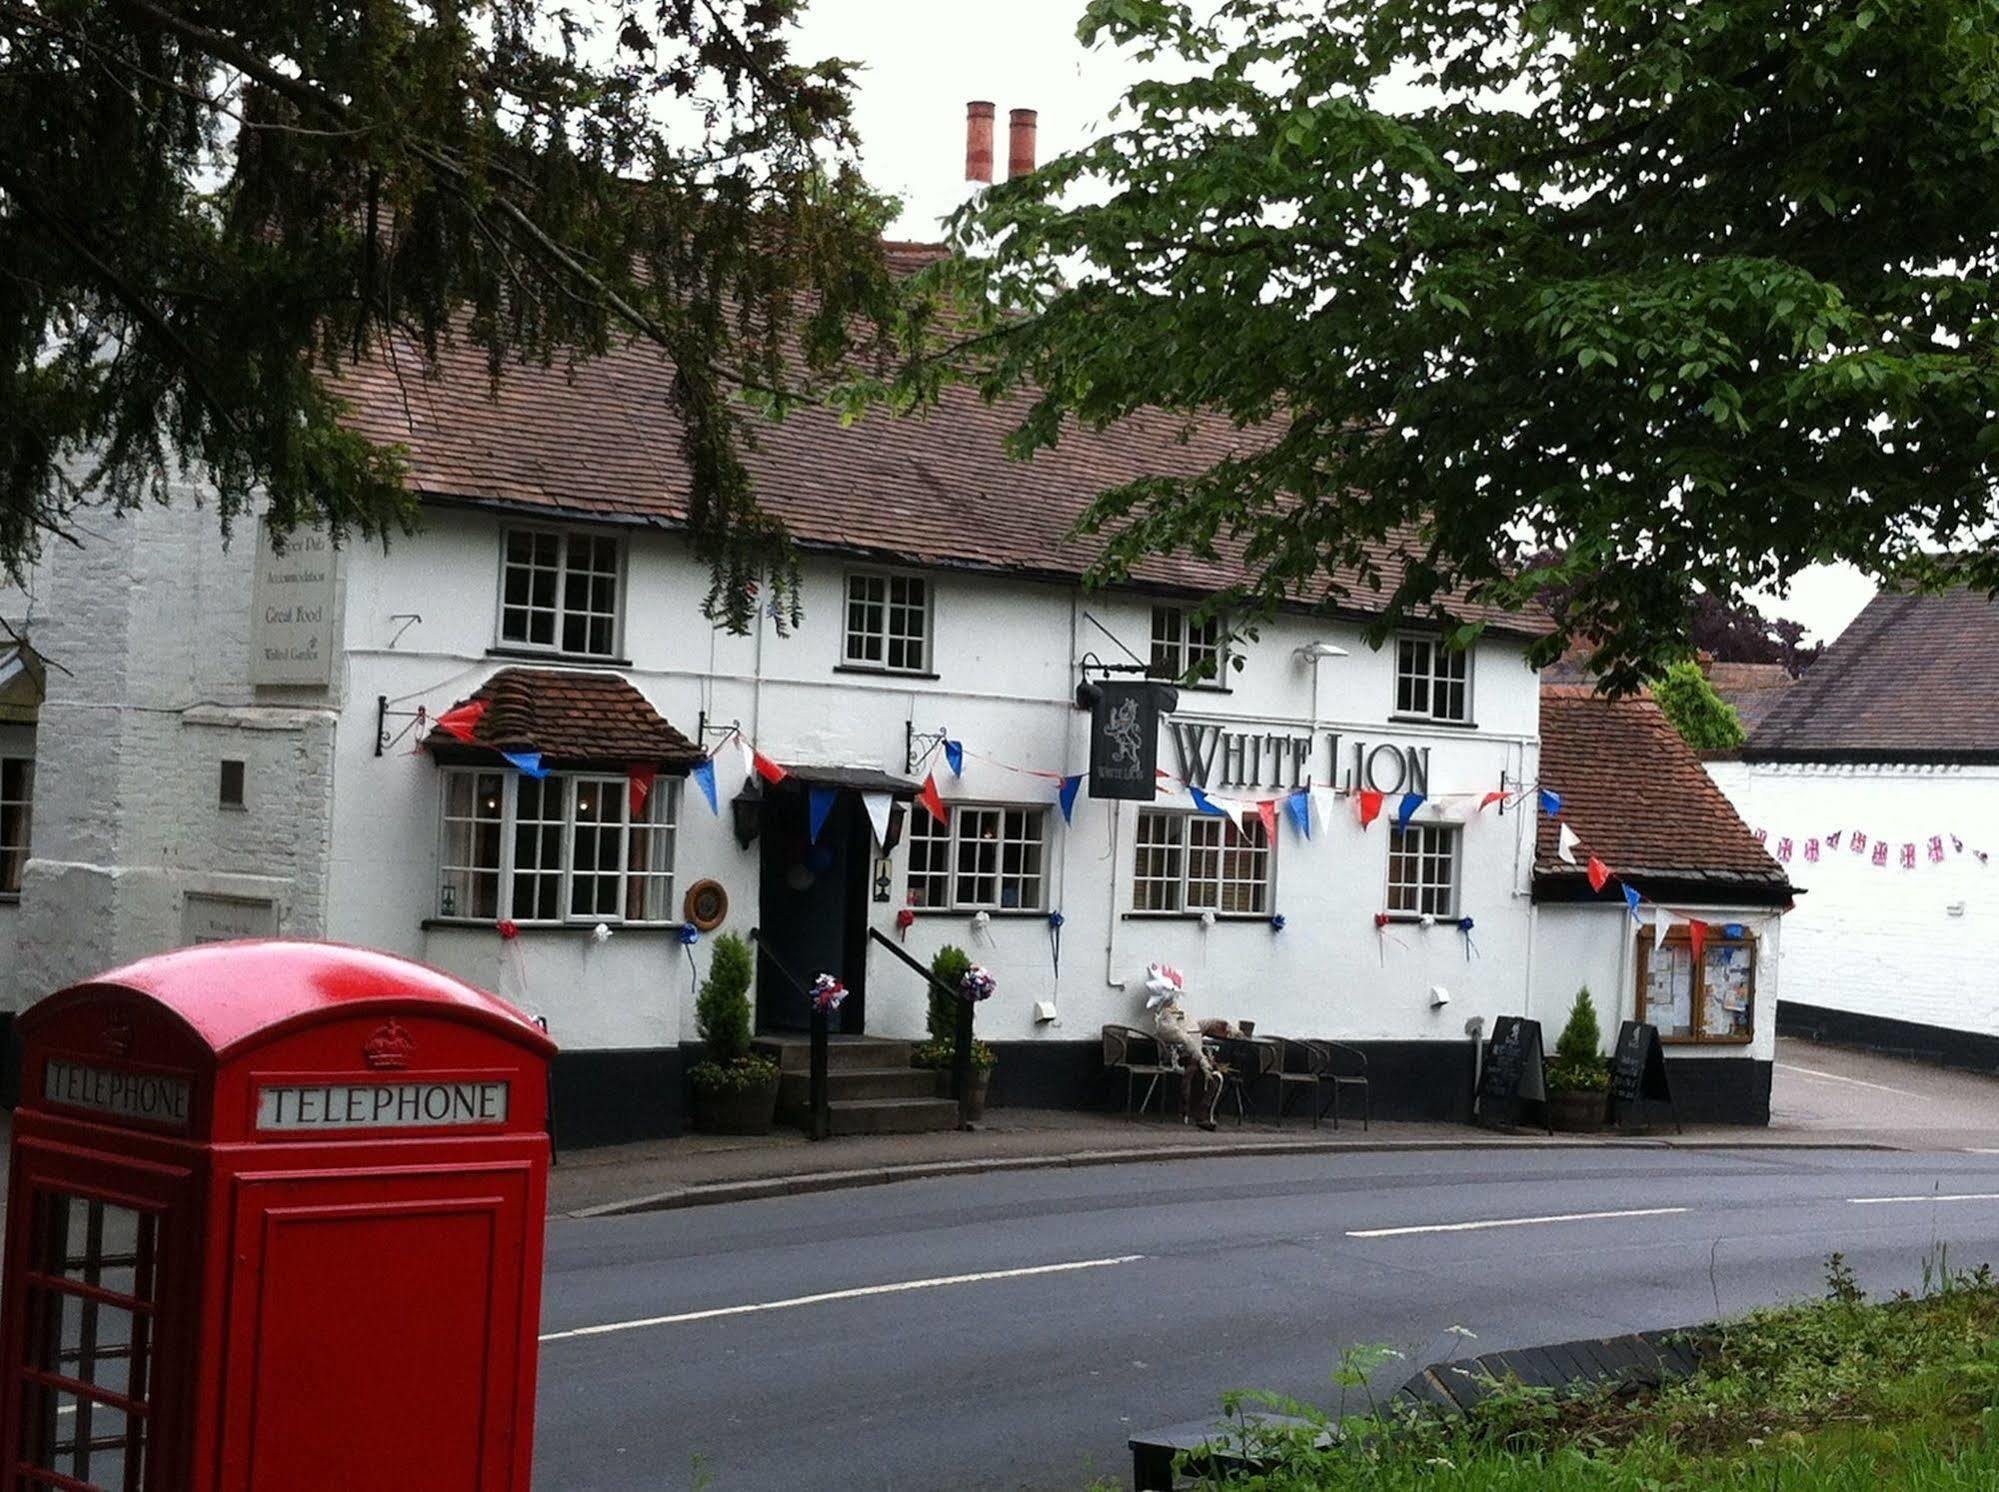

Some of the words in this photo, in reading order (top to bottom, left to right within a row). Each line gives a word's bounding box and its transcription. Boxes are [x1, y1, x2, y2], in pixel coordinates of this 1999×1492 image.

[265, 606, 292, 624] Great
[296, 604, 323, 624] Food
[1168, 721, 1312, 793] WHITE
[1327, 733, 1431, 801] LION
[50, 1061, 188, 1118] TELEPHONE
[268, 1085, 500, 1123] TELEPHONE
